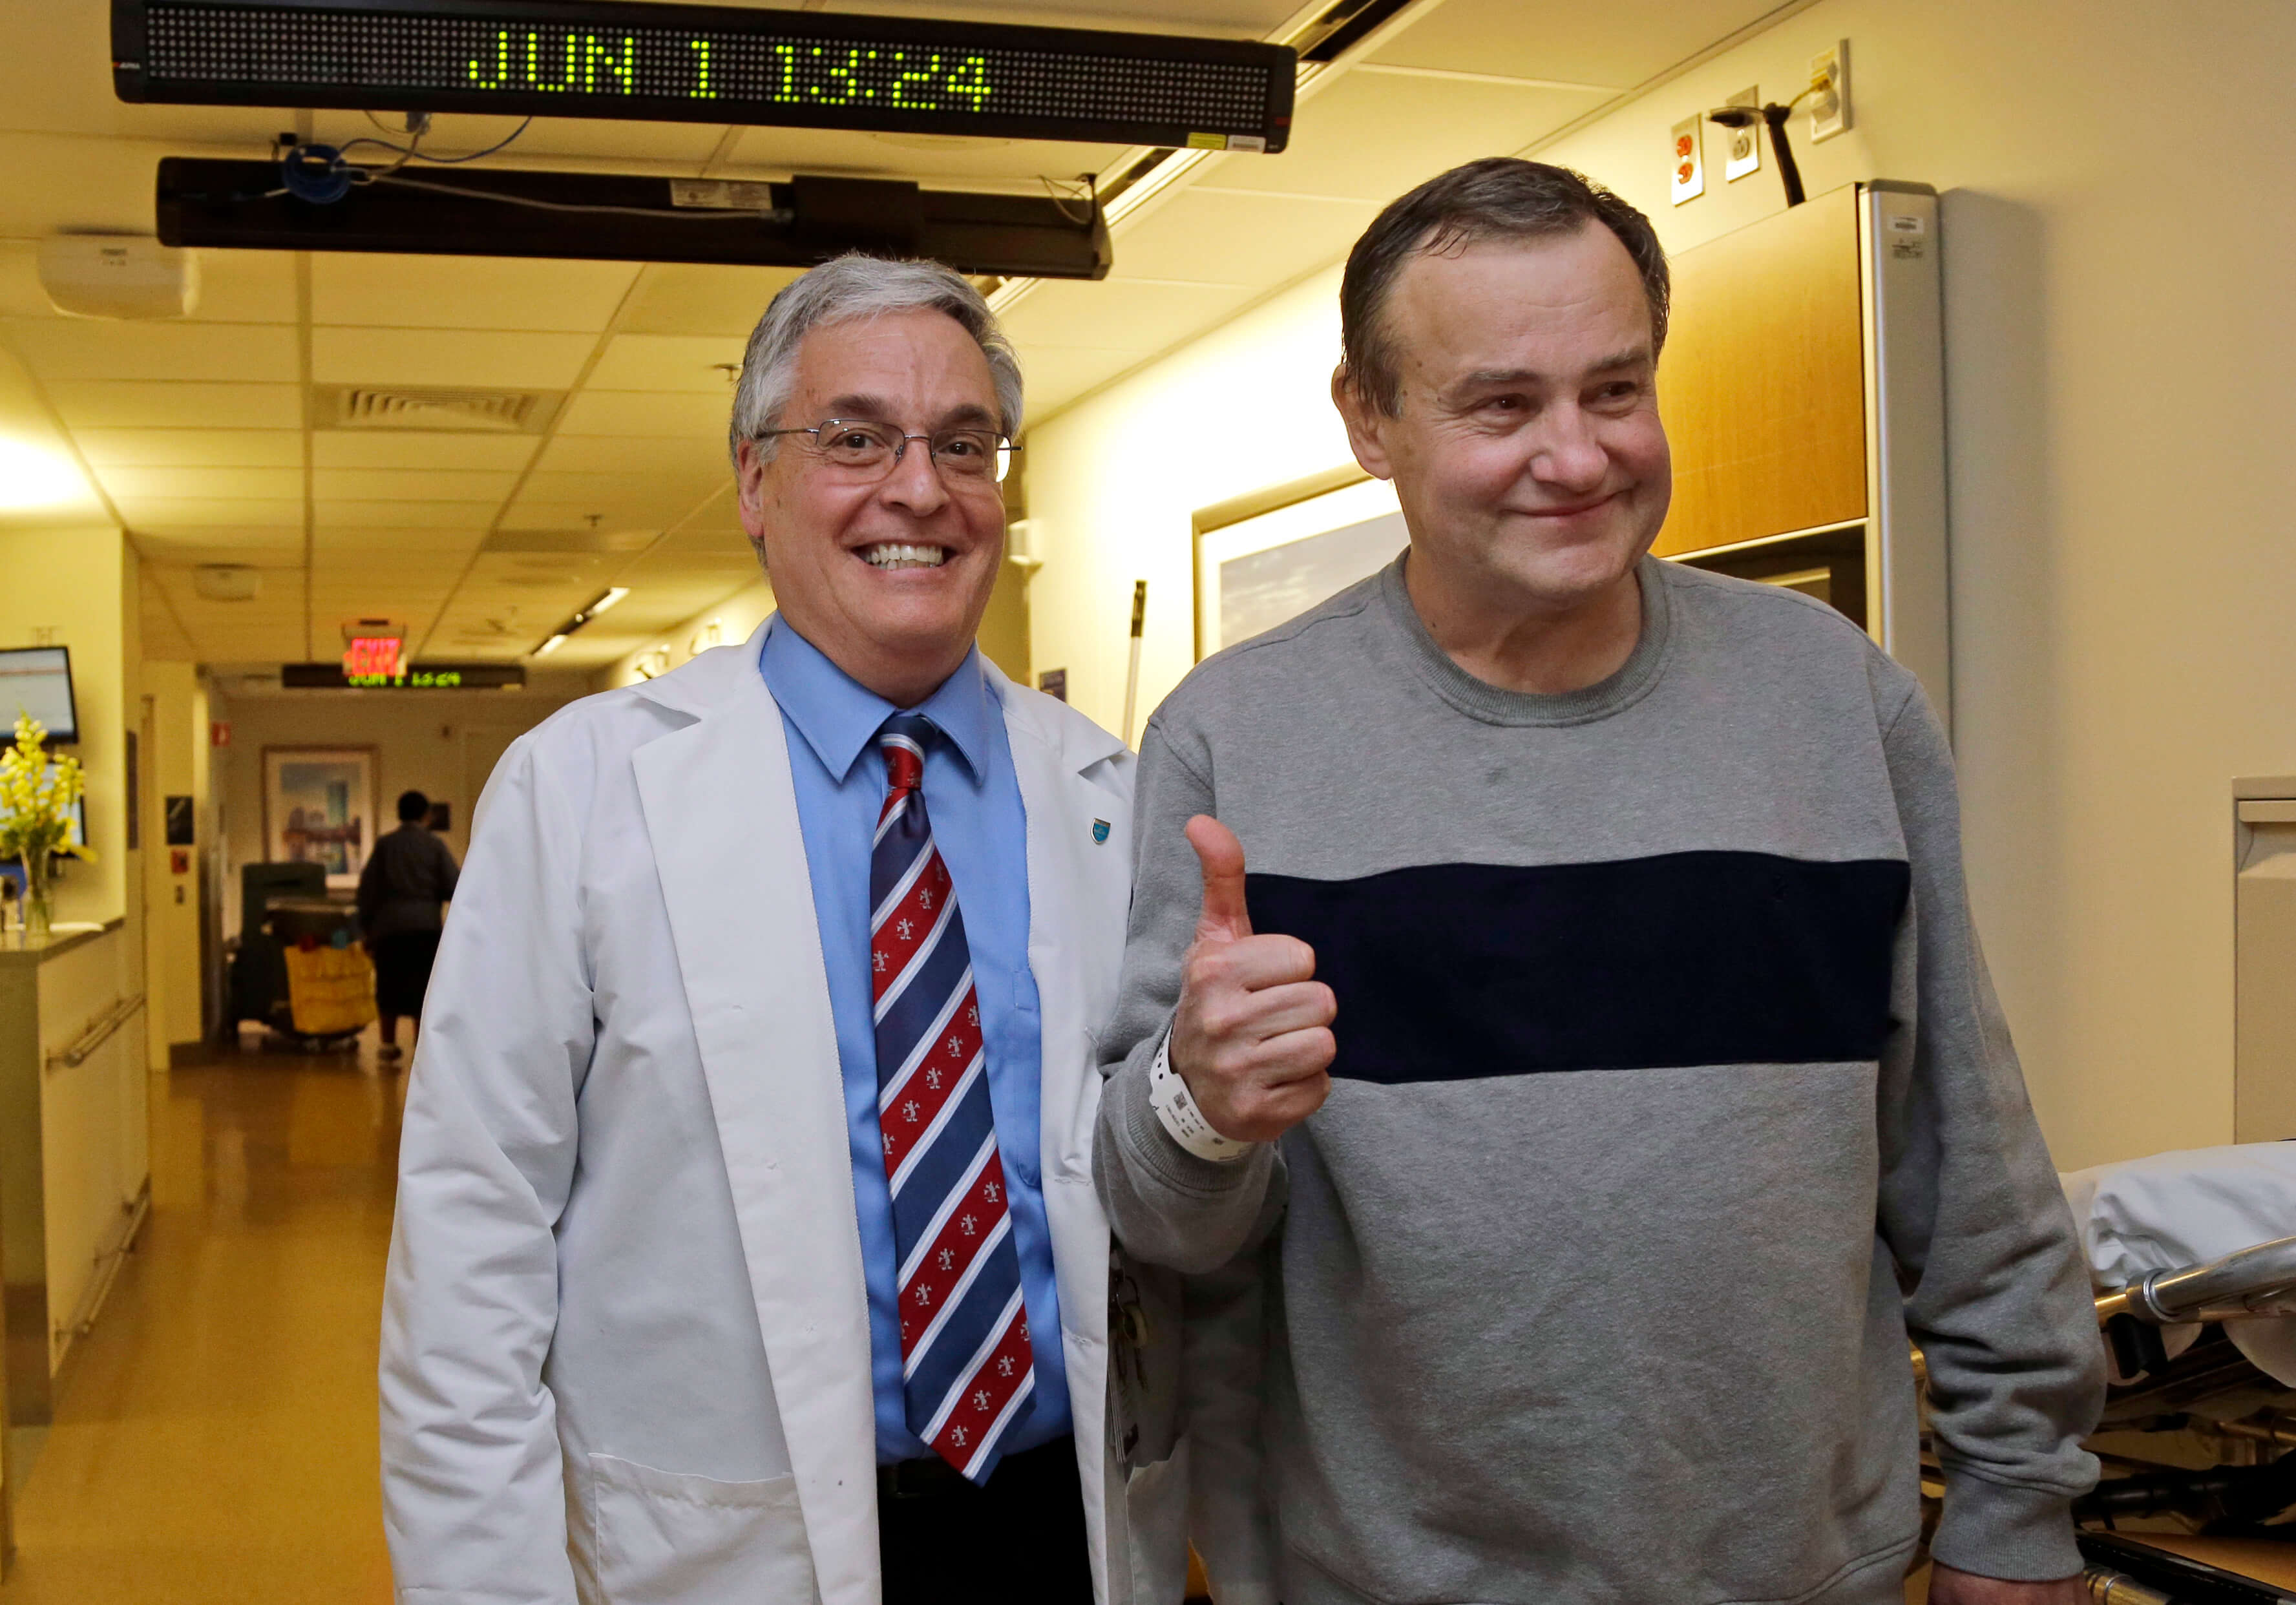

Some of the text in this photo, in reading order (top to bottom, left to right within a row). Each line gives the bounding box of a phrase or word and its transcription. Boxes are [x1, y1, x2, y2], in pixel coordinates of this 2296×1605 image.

[468, 30, 992, 112] JUN 1 13:24
[352, 638, 400, 675] EXIT
